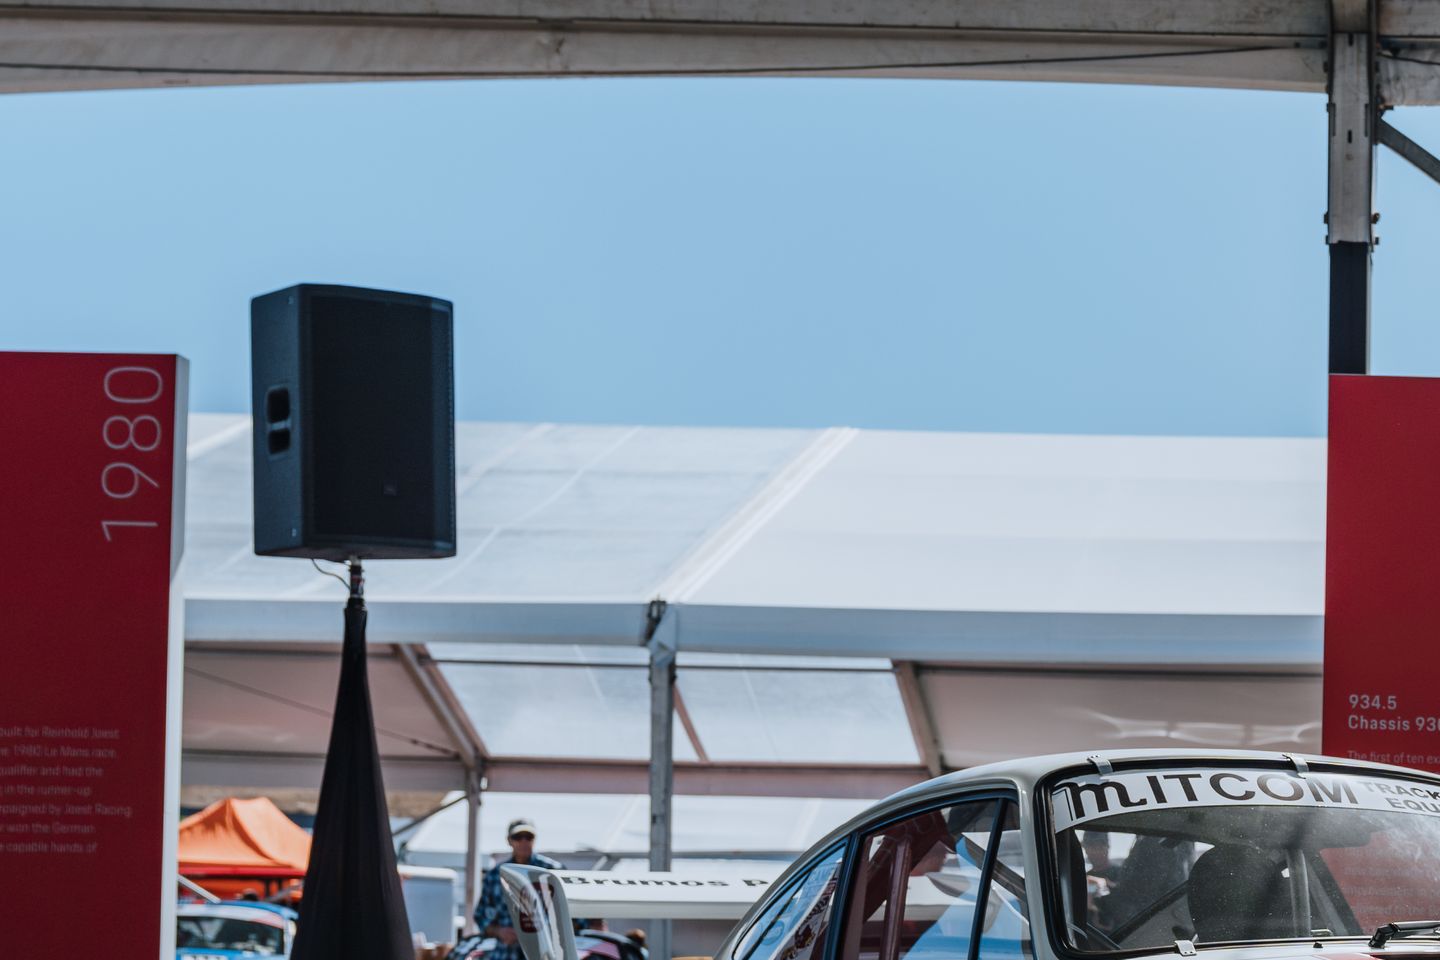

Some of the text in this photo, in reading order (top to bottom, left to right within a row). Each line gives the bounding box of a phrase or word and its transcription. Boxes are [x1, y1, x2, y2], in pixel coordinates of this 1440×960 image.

[101, 366, 163, 542] 1980
[1349, 694, 1398, 710] 934.5
[1348, 714, 1411, 731] Chassis
[1371, 751, 1392, 764] first
[1393, 752, 1406, 765] of
[1407, 754, 1425, 764] ten
[560, 876, 729, 887] Brumos
